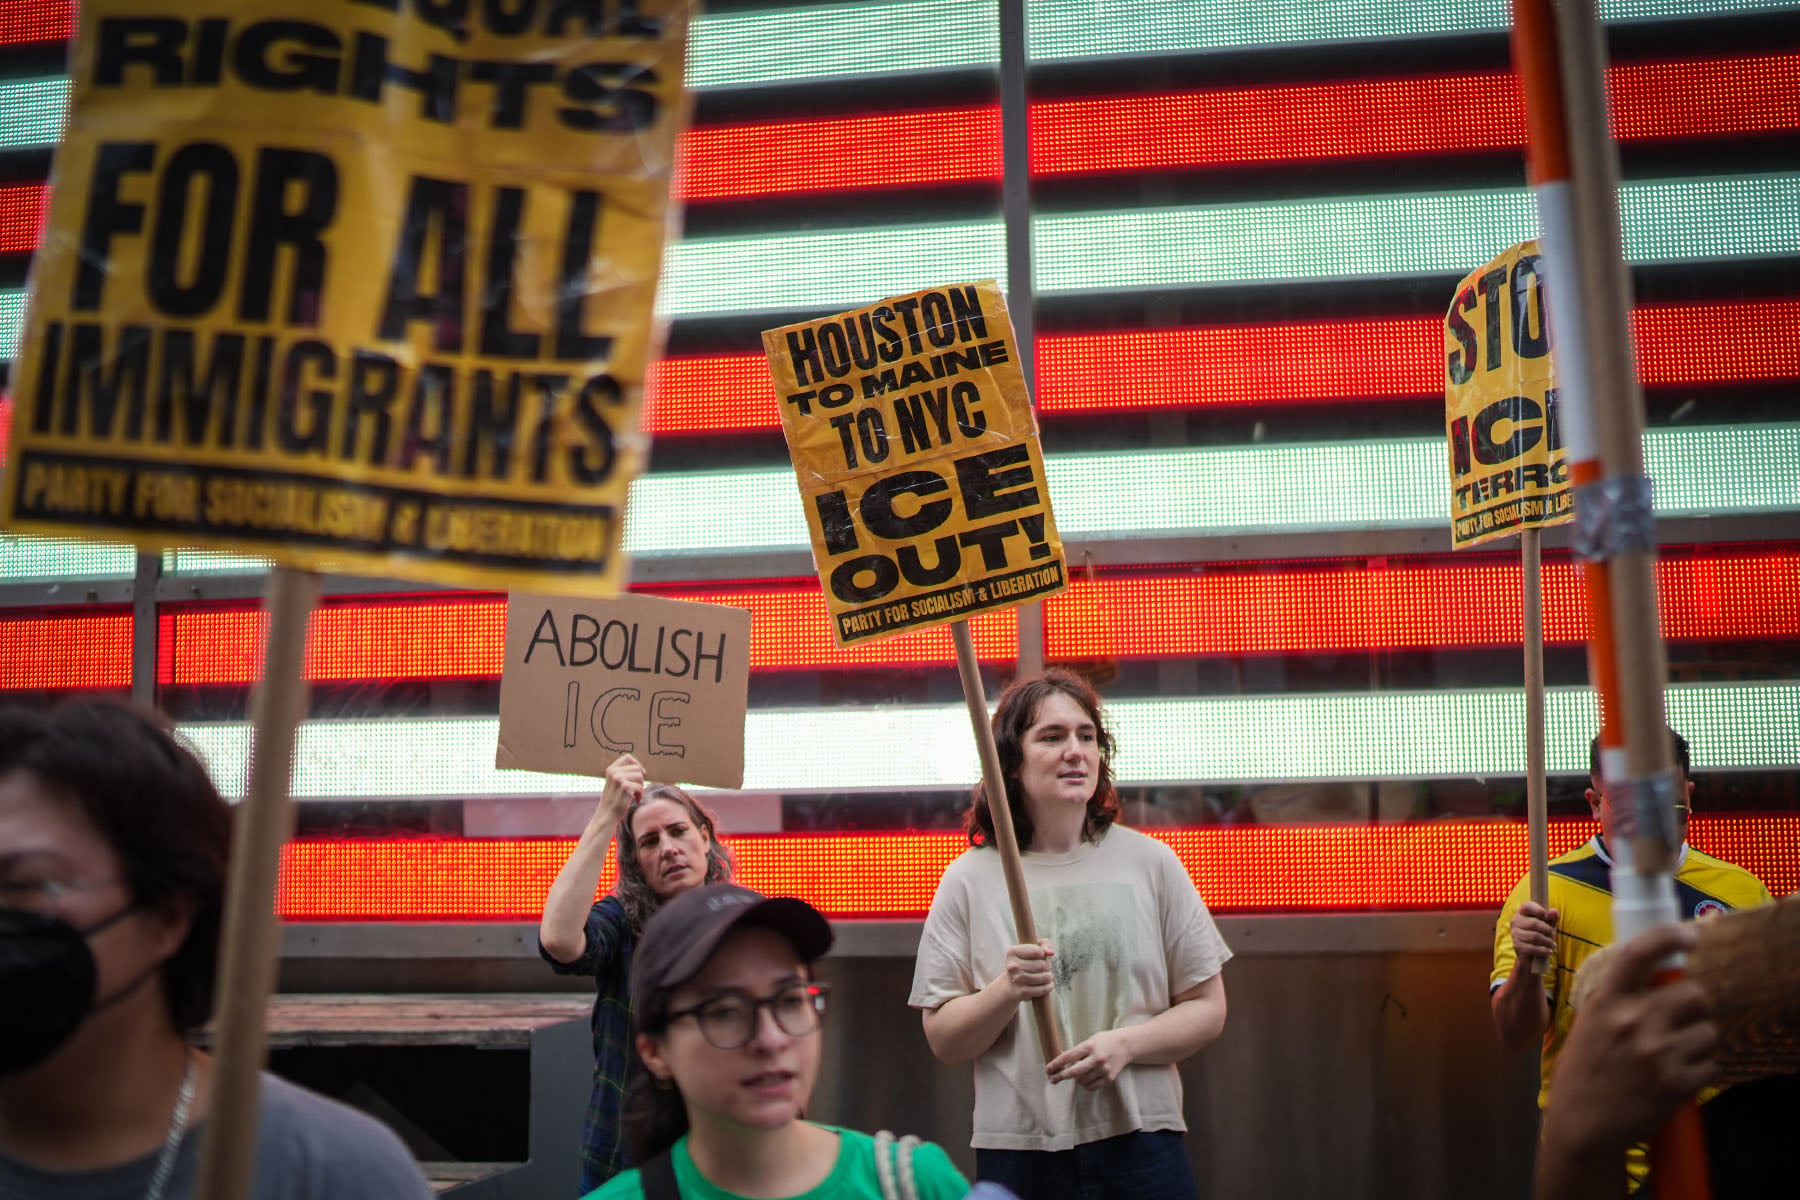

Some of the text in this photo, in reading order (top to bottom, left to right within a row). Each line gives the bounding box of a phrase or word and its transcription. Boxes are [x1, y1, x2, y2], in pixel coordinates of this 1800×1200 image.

[93, 17, 660, 135] RIGHTS
[71, 142, 616, 361] FOR ALL
[786, 285, 988, 388] HOUSTON
[1448, 254, 1552, 386] STO
[32, 318, 624, 488] IMMIGRANTS
[787, 340, 1009, 416] TO MAINE
[830, 381, 987, 470] TO NYC
[1450, 388, 1562, 479] IC
[23, 461, 128, 518] PARTY
[132, 470, 198, 523] FOR
[204, 477, 385, 544] SOCIALISM
[815, 443, 1041, 555] ICE
[1455, 457, 1569, 510] TERRO
[1456, 516, 1478, 538] PARTY
[1480, 512, 1494, 529] FOR
[1494, 500, 1544, 525] SOCIALISM
[1555, 492, 1575, 513] LIBE
[830, 513, 1052, 604] OUT!
[841, 566, 1059, 635] PARTY FOR SOCIALISM & LIBERATION
[523, 609, 726, 683] ABOLISH
[564, 681, 690, 759] ICE
